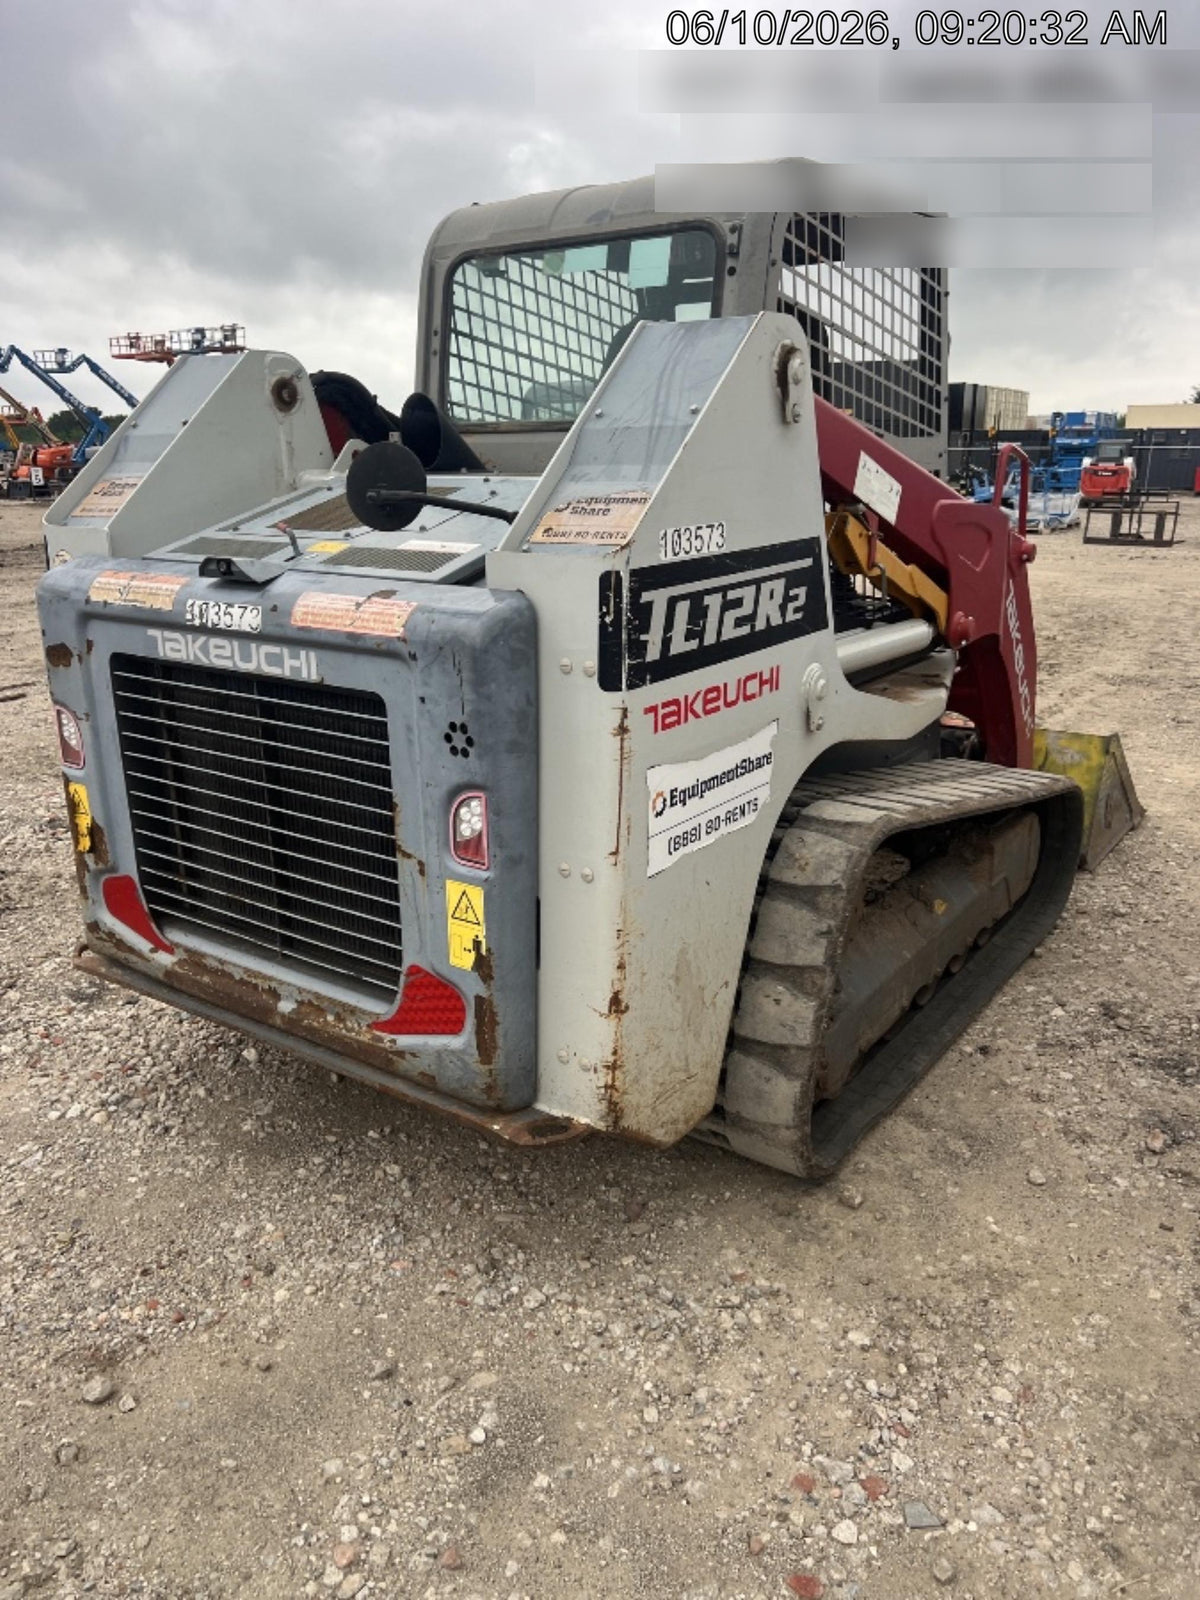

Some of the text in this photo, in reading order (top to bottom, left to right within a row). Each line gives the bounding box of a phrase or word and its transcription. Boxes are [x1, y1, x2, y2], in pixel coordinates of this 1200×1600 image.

[661, 522, 725, 558] 103573
[669, 752, 773, 807] EquipmentShare
[705, 797, 759, 836] 80-RENTS
